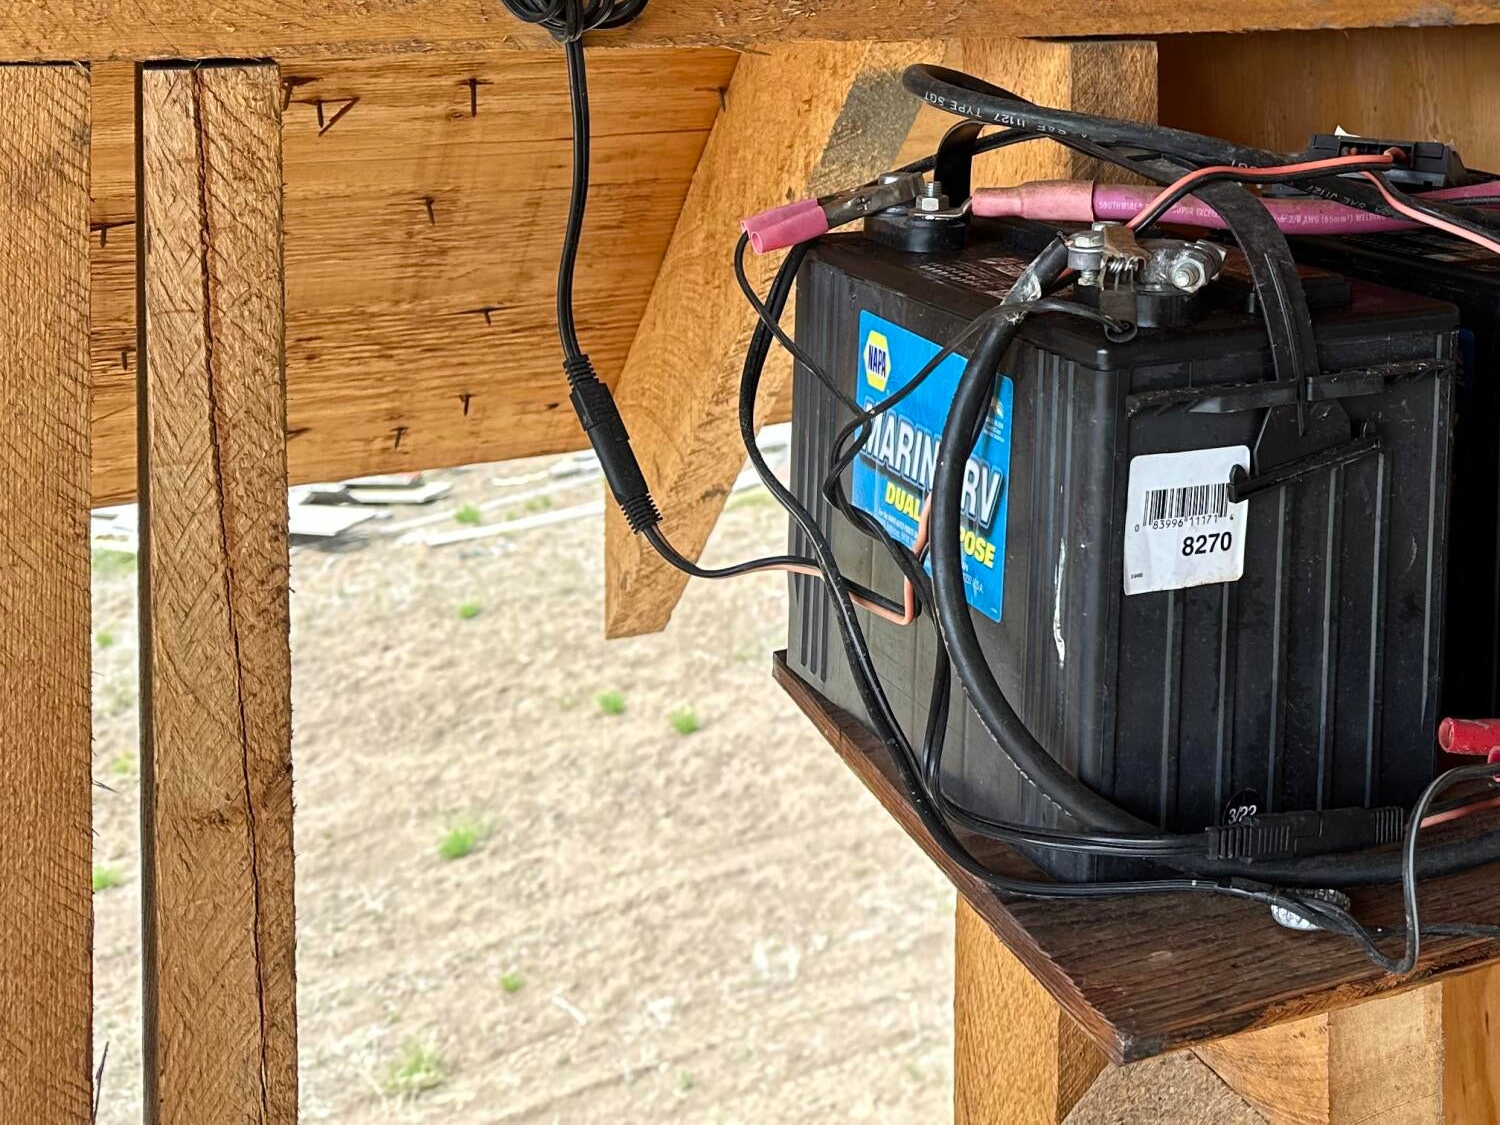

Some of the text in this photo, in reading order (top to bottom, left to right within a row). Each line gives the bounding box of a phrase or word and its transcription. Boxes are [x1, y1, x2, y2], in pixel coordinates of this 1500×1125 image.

[923, 91, 945, 106] SGT
[949, 99, 982, 118] TYPE
[868, 344, 887, 378] NAPA
[861, 399, 941, 492] MARIN
[885, 481, 921, 523] DUAL
[1152, 519, 1184, 530] 83996
[1190, 514, 1218, 526] 11171
[1181, 531, 1233, 557] 8270
